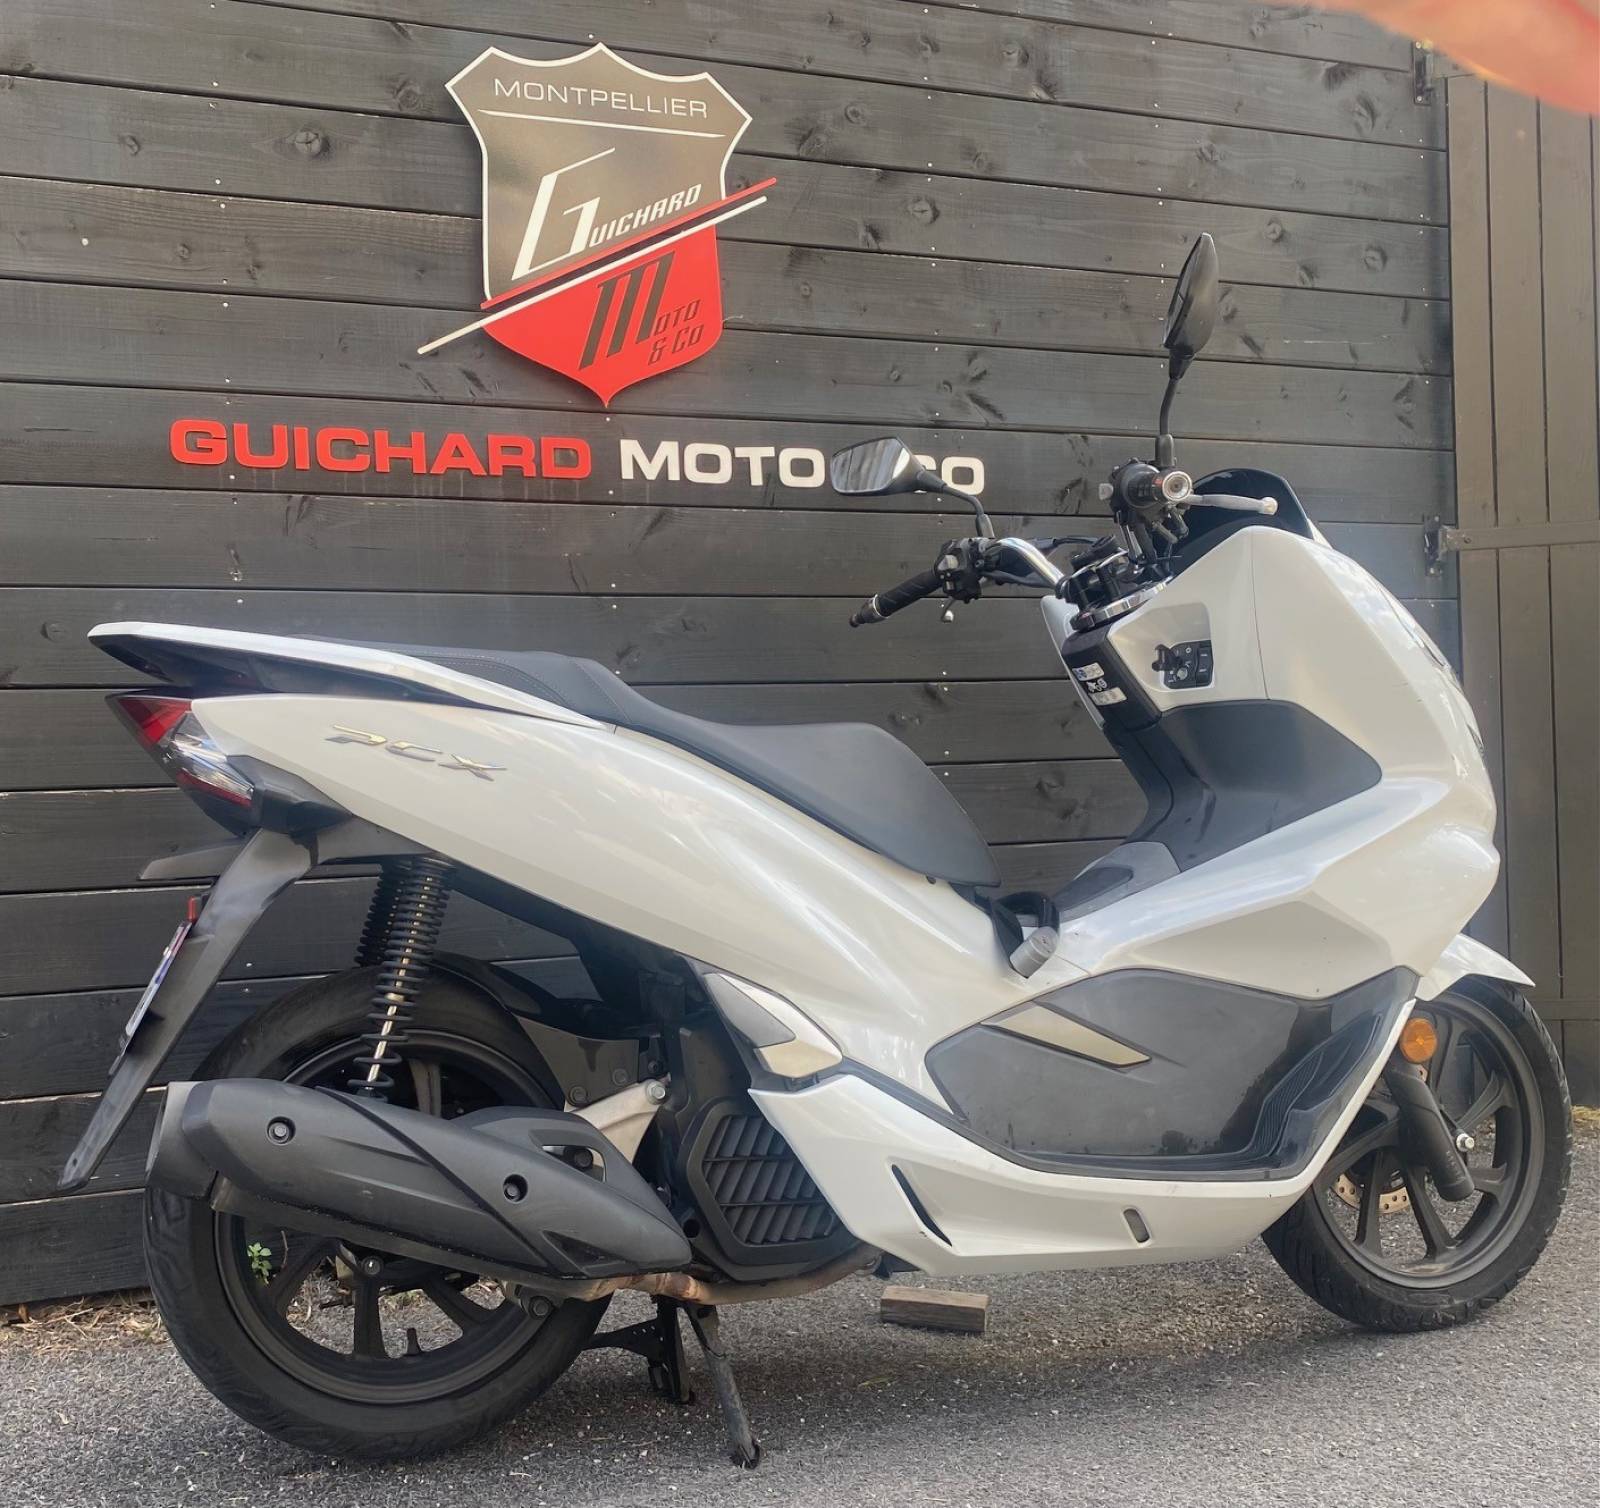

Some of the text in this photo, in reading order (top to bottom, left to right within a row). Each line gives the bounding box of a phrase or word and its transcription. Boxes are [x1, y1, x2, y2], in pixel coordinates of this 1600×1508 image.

[494, 78, 708, 119] MONTPELLIER
[511, 147, 702, 281] GUICHARD
[578, 250, 702, 370] MOTO
[648, 337, 668, 366] &
[170, 419, 592, 479] GUICHARD
[620, 439, 826, 488] MOTO
[325, 724, 508, 782] PCX
